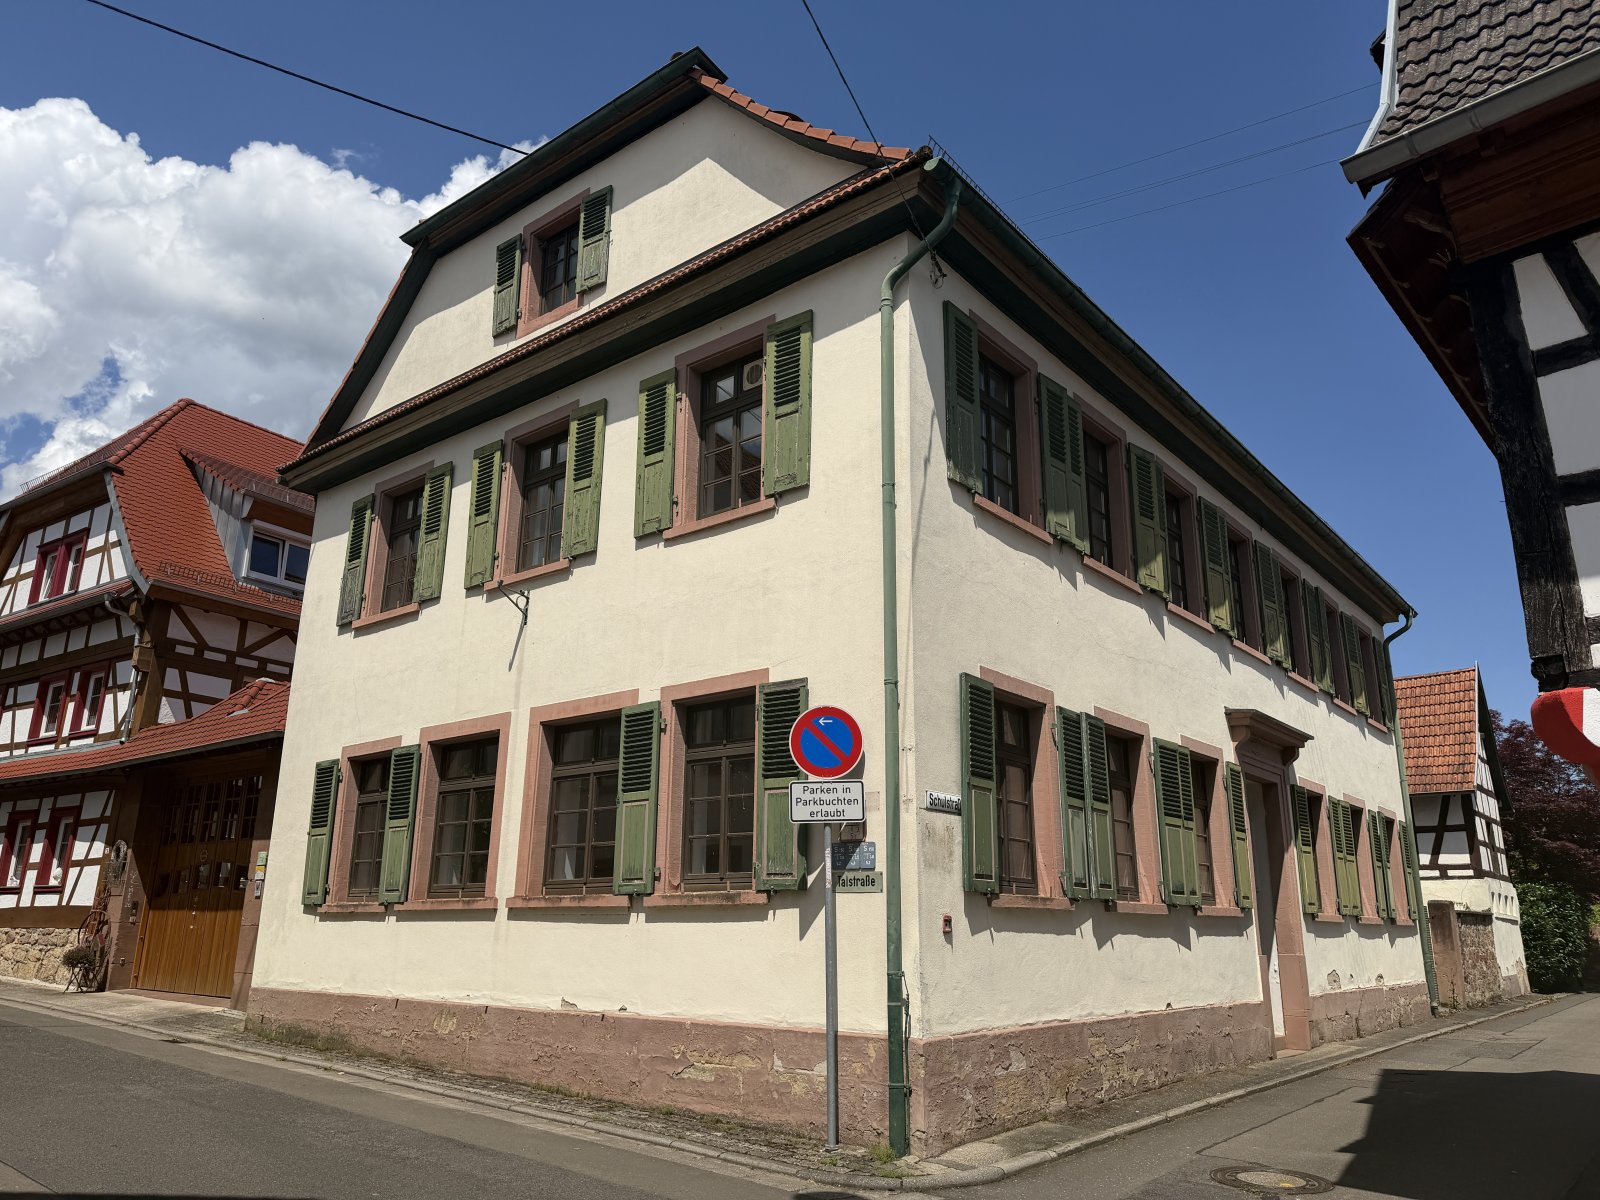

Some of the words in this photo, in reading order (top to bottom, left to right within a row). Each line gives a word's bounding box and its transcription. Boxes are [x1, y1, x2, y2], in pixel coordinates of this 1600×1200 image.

[802, 785, 838, 794] Parken
[842, 784, 851, 794] in
[795, 796, 859, 806] Parkbuchten
[809, 808, 846, 818] erlaubt
[837, 874, 876, 888] Talstraße
